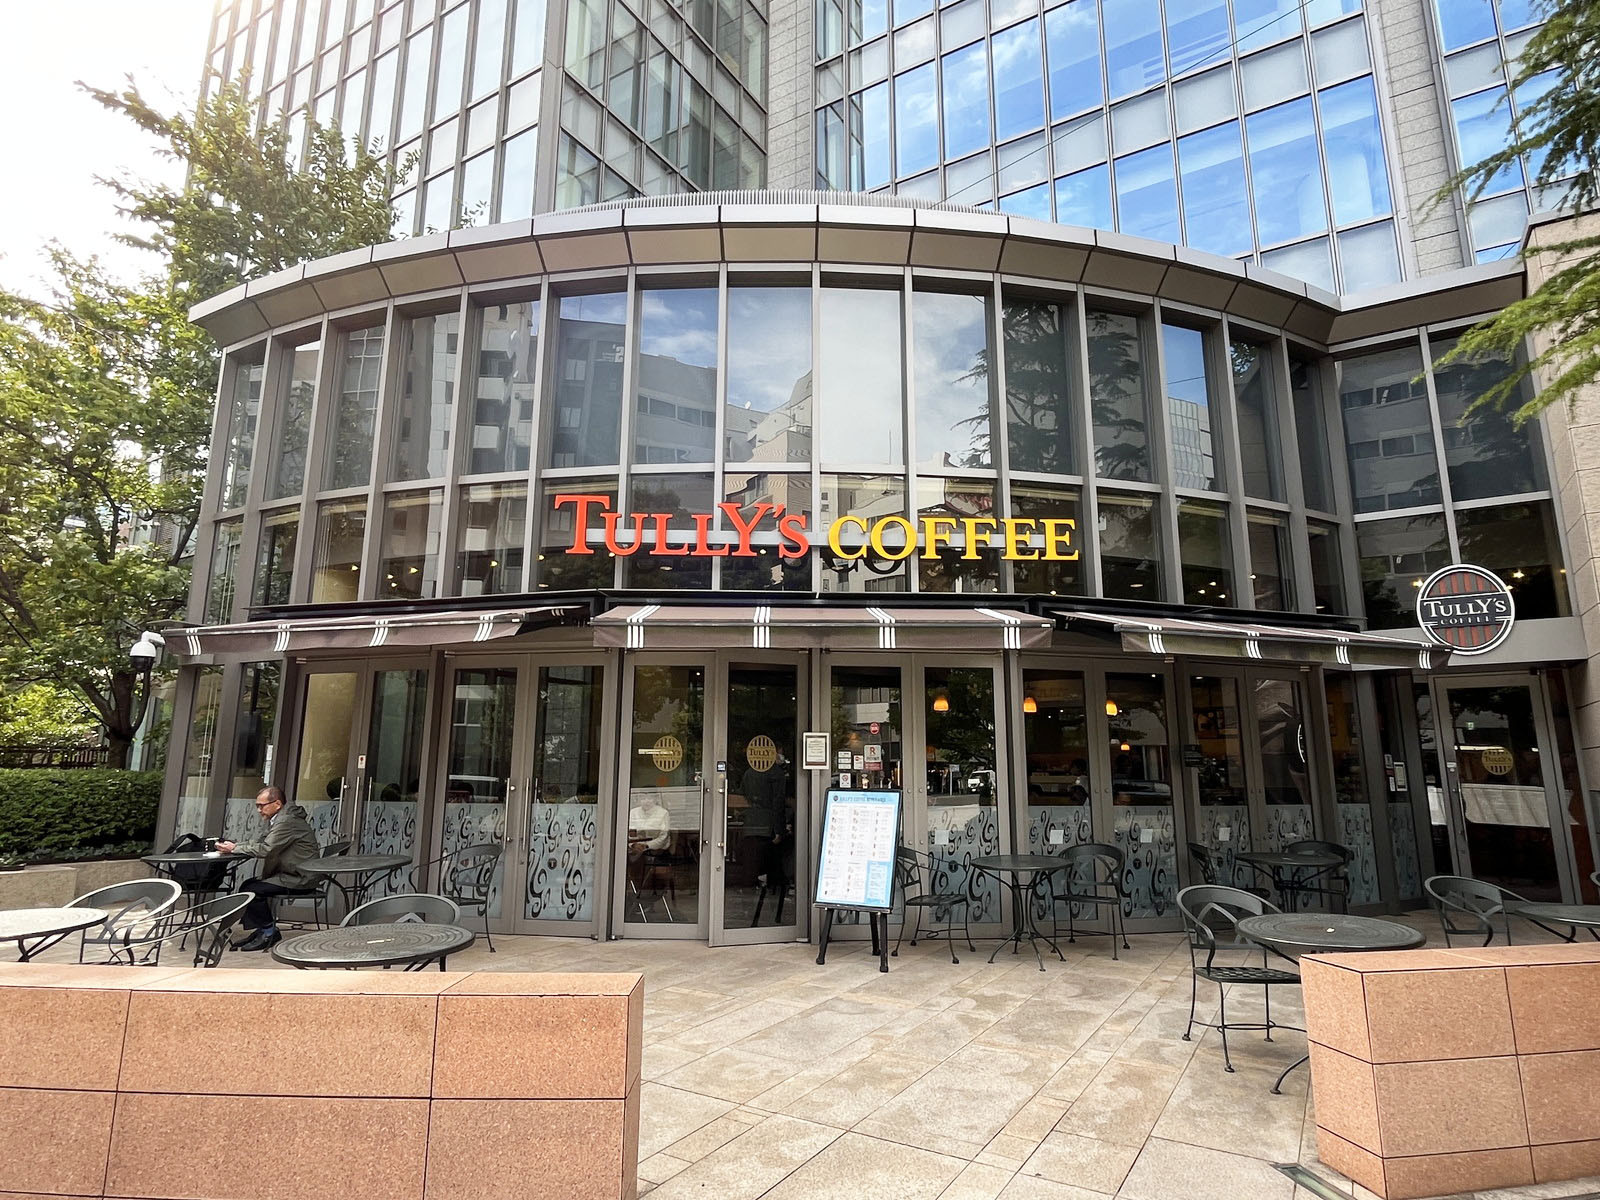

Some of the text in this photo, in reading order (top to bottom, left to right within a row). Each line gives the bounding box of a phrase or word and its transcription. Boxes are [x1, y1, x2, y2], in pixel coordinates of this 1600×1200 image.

[554, 494, 1080, 561] TULLY'S COFFEE
[1423, 598, 1507, 618] TULLY'S
